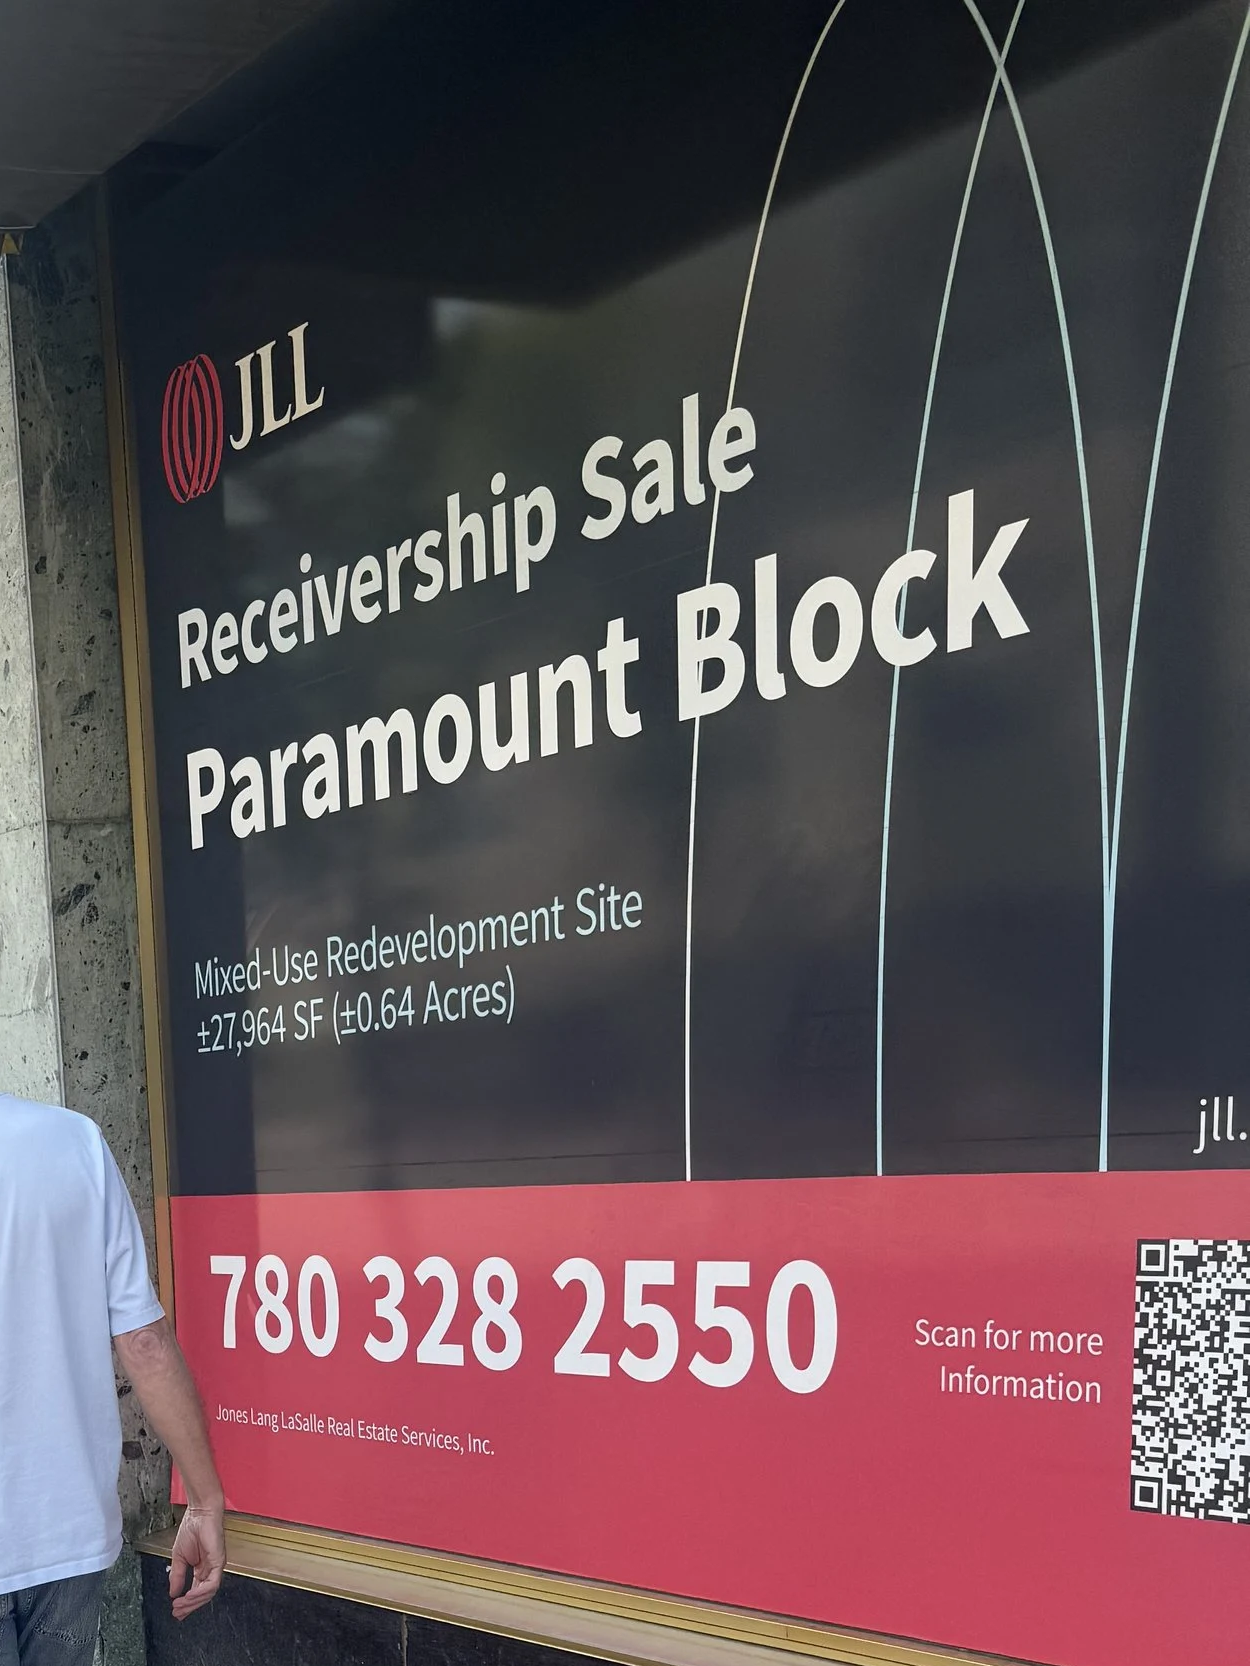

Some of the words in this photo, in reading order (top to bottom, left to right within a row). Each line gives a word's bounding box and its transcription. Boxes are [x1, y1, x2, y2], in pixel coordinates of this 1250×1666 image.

[229, 322, 325, 450] JLL
[178, 472, 556, 689] Receivership
[581, 392, 756, 540] Sale
[186, 616, 642, 850] Paramount
[677, 488, 1030, 722] Block
[194, 944, 319, 1000] Mixed-Use
[326, 896, 565, 979] Redevelopment
[575, 883, 643, 936] Site
[196, 1004, 286, 1057] ±27,964
[293, 997, 324, 1043] SF
[332, 985, 415, 1045] (±0.64
[422, 964, 516, 1024] Acres)
[1193, 1096, 1247, 1154] jll.
[209, 1254, 340, 1358] 780
[362, 1255, 523, 1371] 328
[551, 1257, 838, 1394] 2550
[914, 1318, 976, 1349] Scan
[984, 1320, 1022, 1351] for
[1029, 1328, 1104, 1356] more
[216, 1403, 248, 1424] Jones
[250, 1408, 279, 1433] Lang
[281, 1411, 325, 1434] LaSalle
[327, 1416, 355, 1438] Real
[358, 1420, 398, 1443] Estate
[401, 1425, 465, 1455] Services,
[468, 1433, 496, 1456] Inc.
[940, 1365, 1101, 1403] Information
